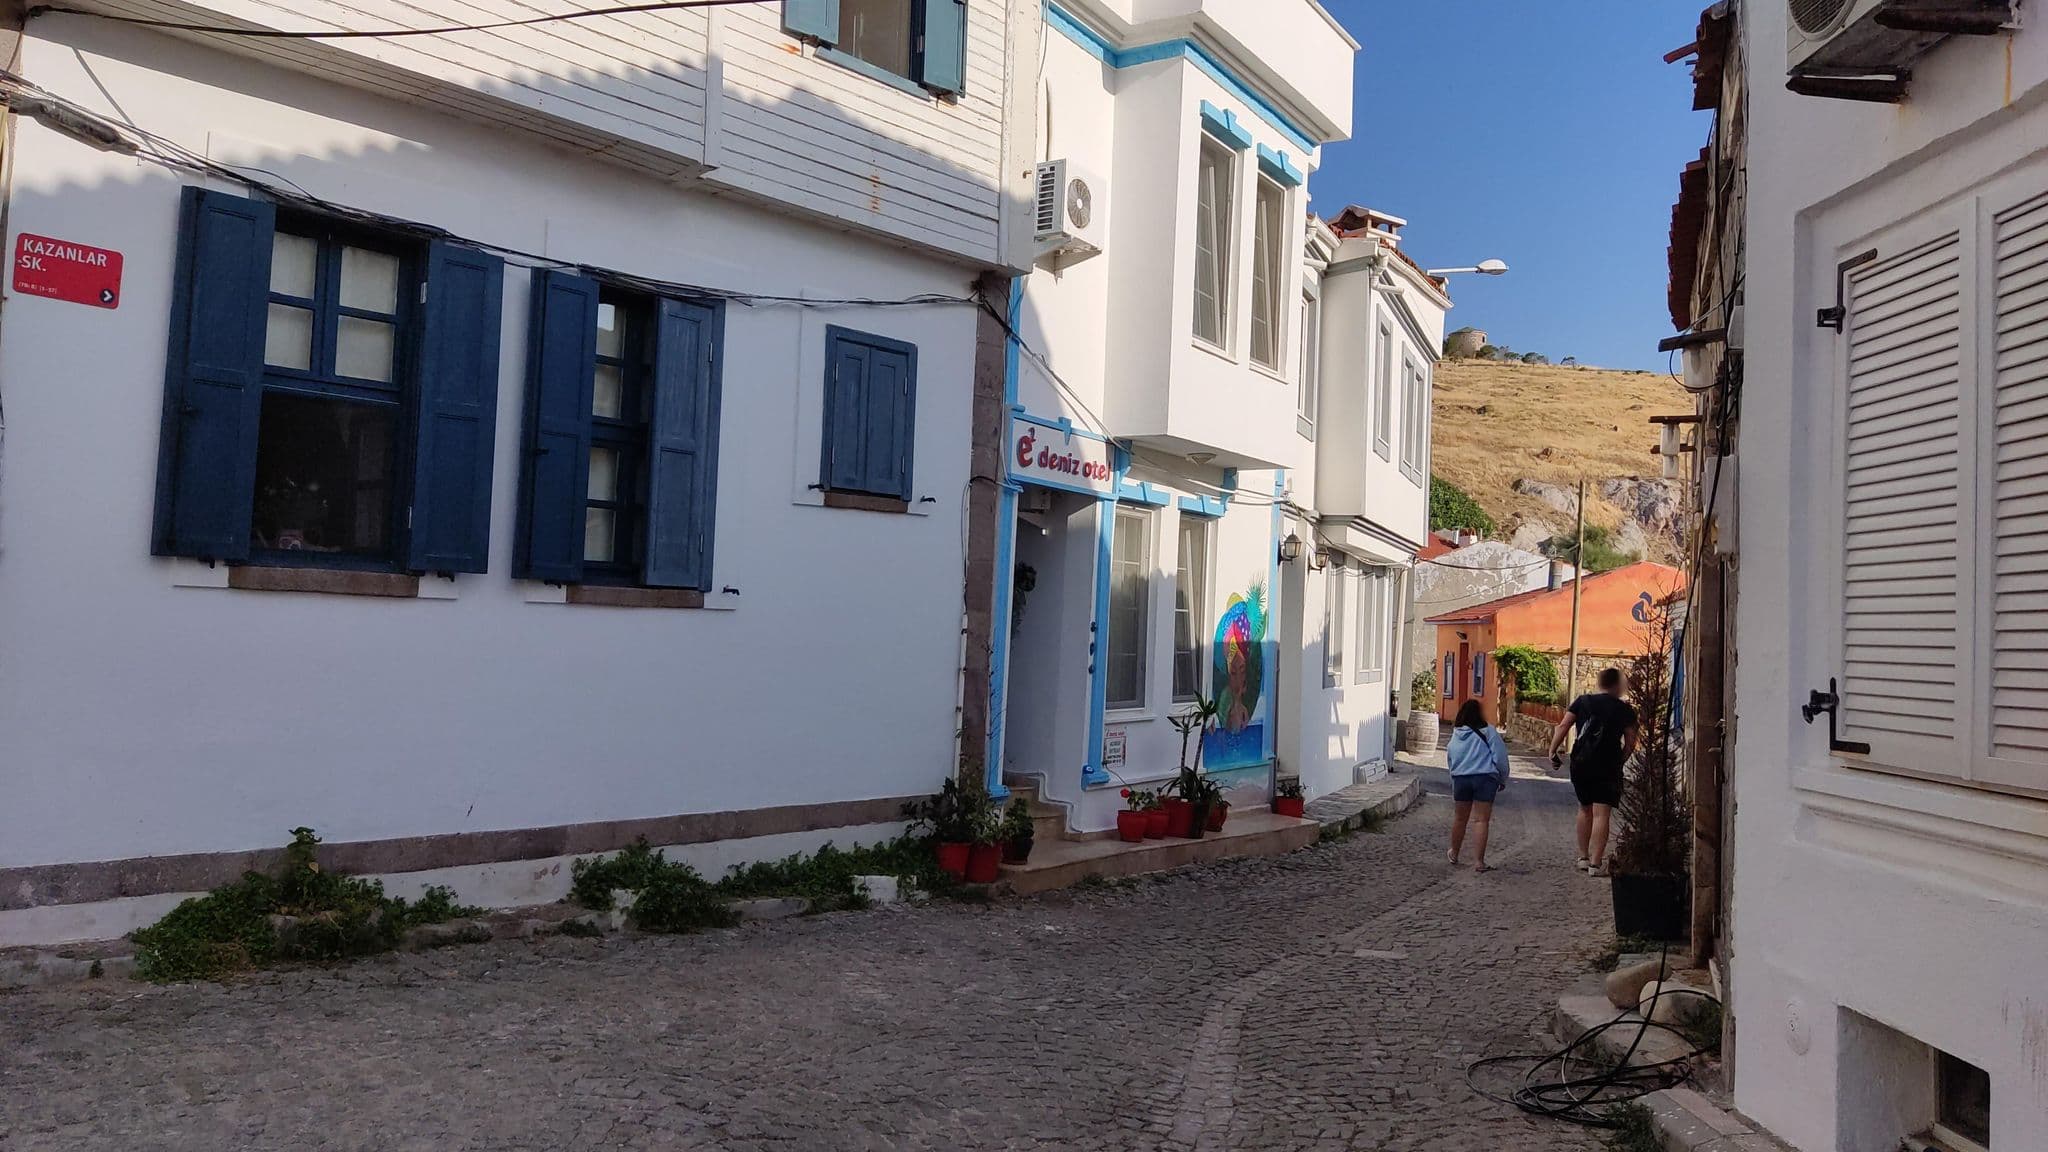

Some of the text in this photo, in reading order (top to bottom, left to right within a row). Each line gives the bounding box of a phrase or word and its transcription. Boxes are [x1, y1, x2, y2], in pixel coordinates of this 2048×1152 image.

[23, 238, 107, 267] KAZANLAR
[1038, 445, 1080, 475] deniz
[1082, 459, 1112, 481] otel
